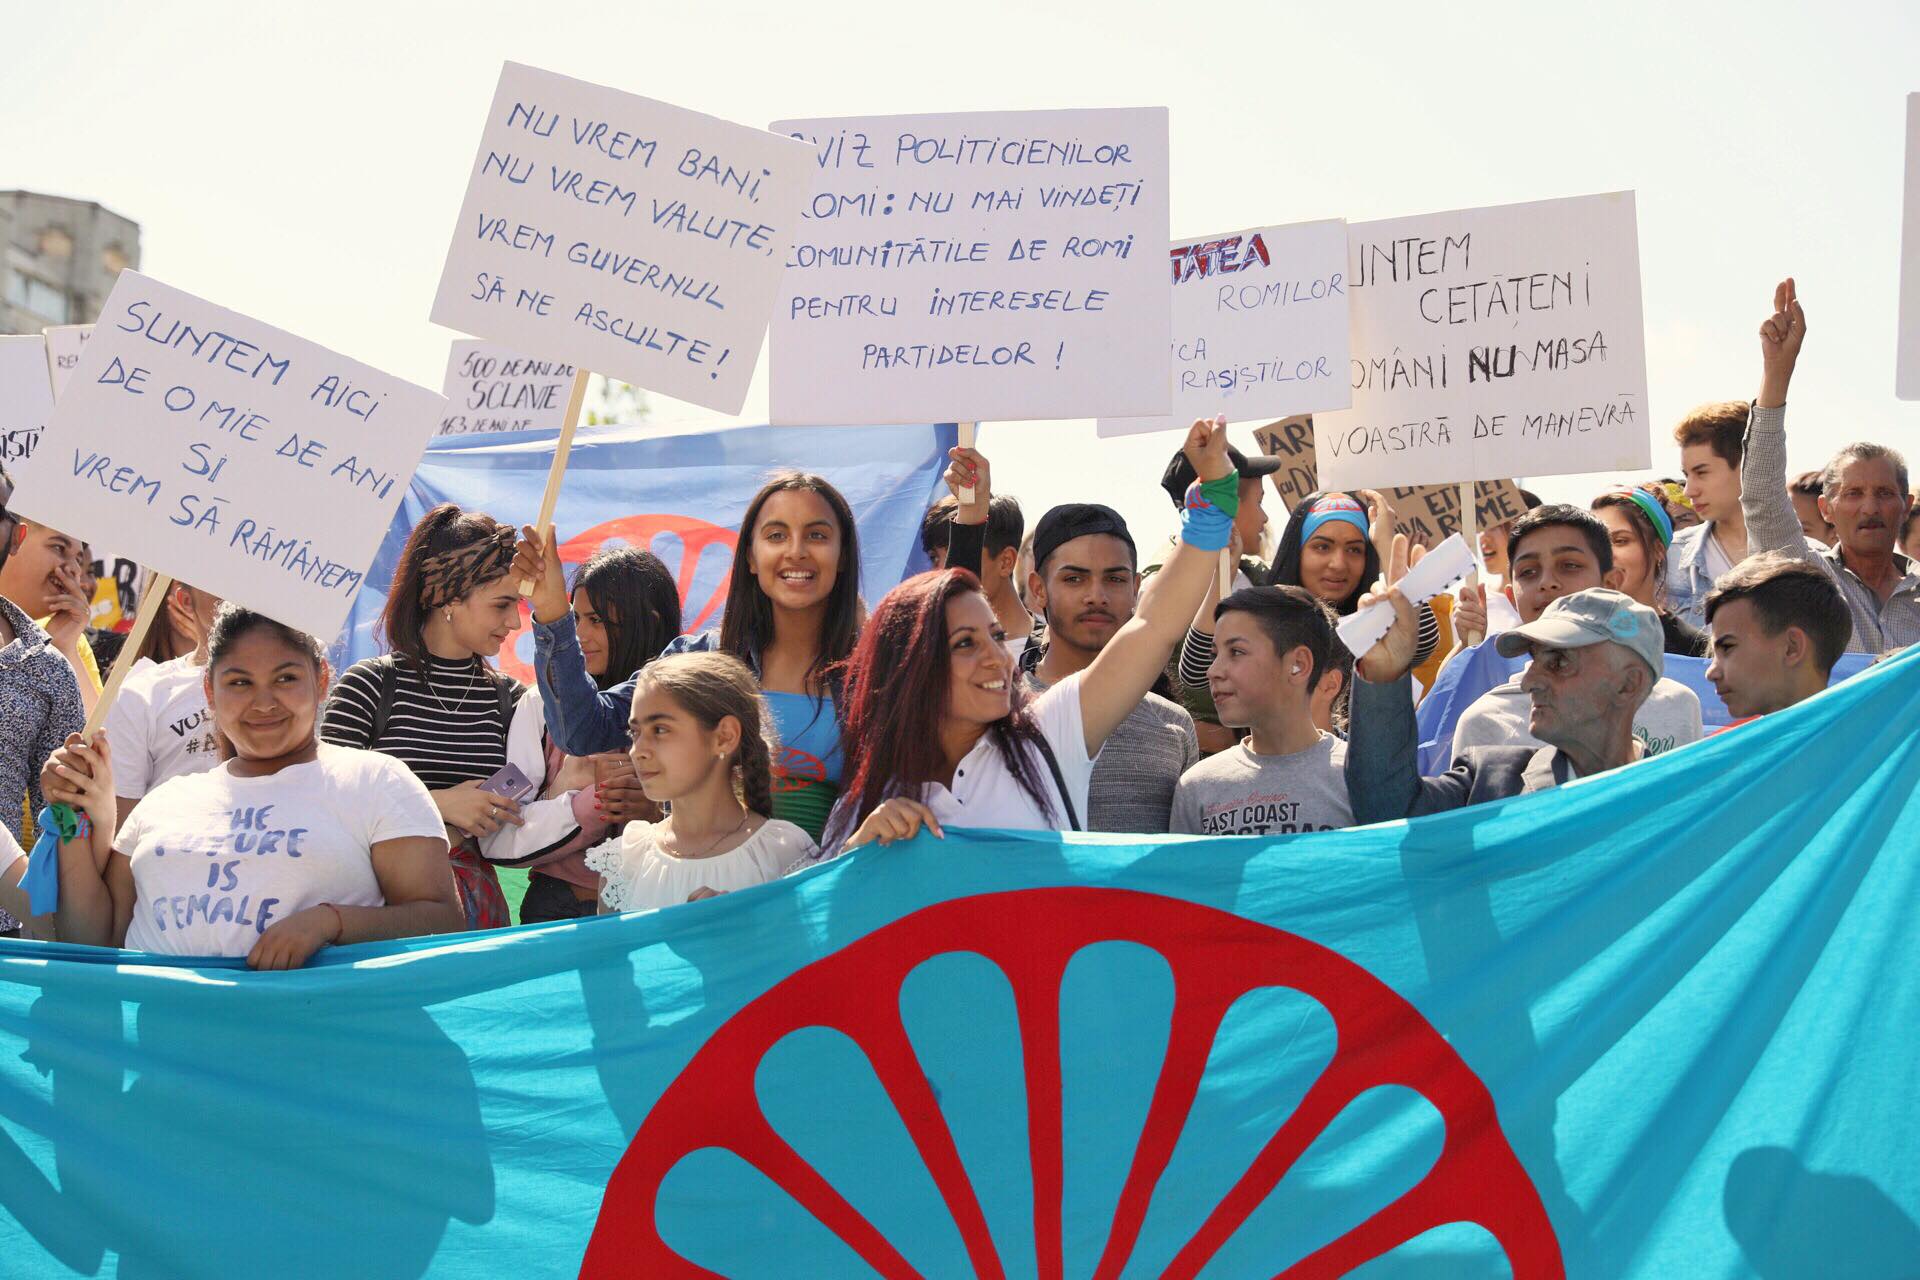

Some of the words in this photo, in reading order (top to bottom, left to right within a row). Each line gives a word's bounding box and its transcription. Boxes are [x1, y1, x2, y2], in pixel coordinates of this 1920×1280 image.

[507, 102, 559, 137] NU
[572, 117, 657, 167] VREM
[897, 133, 1132, 167] POLITICIENILOR
[482, 151, 534, 184] NU
[551, 166, 636, 217] VREM
[653, 199, 776, 256] VALUTE,
[801, 185, 895, 219] OMI:
[908, 190, 953, 214] NU
[971, 187, 1024, 211] MAI
[1040, 178, 1144, 212] VINDEȚI
[478, 213, 555, 258] VREM
[568, 242, 725, 310] GUVERNUL
[1008, 238, 1047, 261] DE
[1062, 234, 1134, 260] ROMI
[471, 272, 506, 303] SĂ
[516, 288, 555, 316] NE
[791, 294, 897, 320] PENTRU
[929, 287, 1109, 316] INTERESELE
[1217, 273, 1345, 312] ROMILOR
[118, 301, 290, 386] SUNTEM
[310, 375, 388, 421] AICI
[459, 350, 497, 378] 500
[500, 359, 523, 377] DE
[862, 341, 1035, 370] PARTIDELOR
[1181, 356, 1332, 392] RASIȘTILOR
[1468, 343, 1517, 384] NU
[1531, 330, 1608, 373] MASA
[467, 379, 562, 411] SCLAVIE
[98, 356, 151, 395] DE
[164, 385, 195, 411] O
[200, 400, 270, 442] MIE
[275, 432, 327, 468] DE
[331, 455, 399, 500] ANI
[440, 416, 467, 435] 163
[1328, 416, 1452, 458] VOASTRĂ
[1472, 413, 1507, 439] DE
[1521, 393, 1636, 439] MANEVRĂ
[182, 442, 228, 483] SI
[73, 448, 161, 505] VREM
[169, 494, 231, 536] SĂ
[230, 518, 362, 598] RĂMÂNEM
[1242, 802, 1300, 825] COAST
[207, 859, 241, 891] IS
[152, 893, 280, 935] FEMALE
